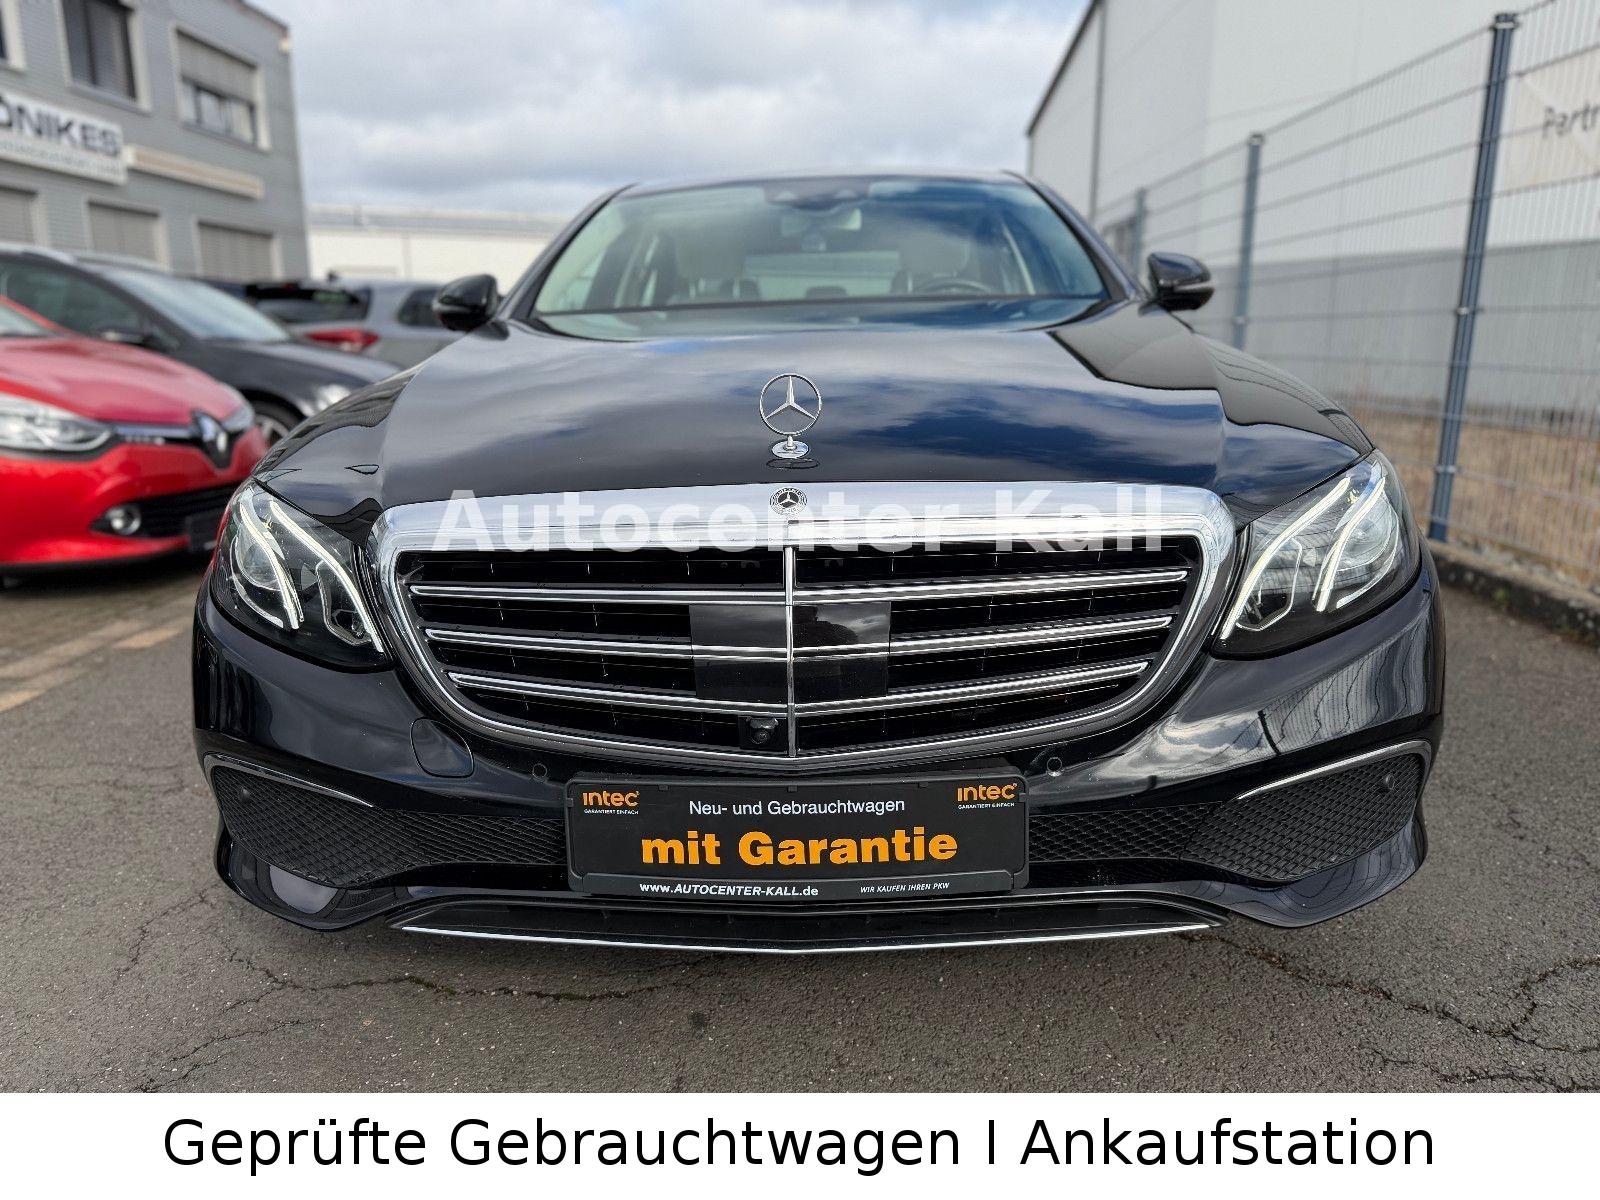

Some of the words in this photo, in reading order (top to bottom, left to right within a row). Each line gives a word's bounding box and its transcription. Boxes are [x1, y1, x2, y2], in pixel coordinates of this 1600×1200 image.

[689, 800, 727, 815] Neu-
[732, 800, 762, 815] und
[767, 799, 905, 817] Gebrauchtwagen
[641, 830, 721, 865] mit
[738, 826, 958, 866] Garantie
[639, 883, 819, 897] www.AUTOCENTER-KALL.de
[876, 884, 907, 893] KAUFEN
[908, 883, 931, 891] IHREN
[932, 882, 950, 890] PKW
